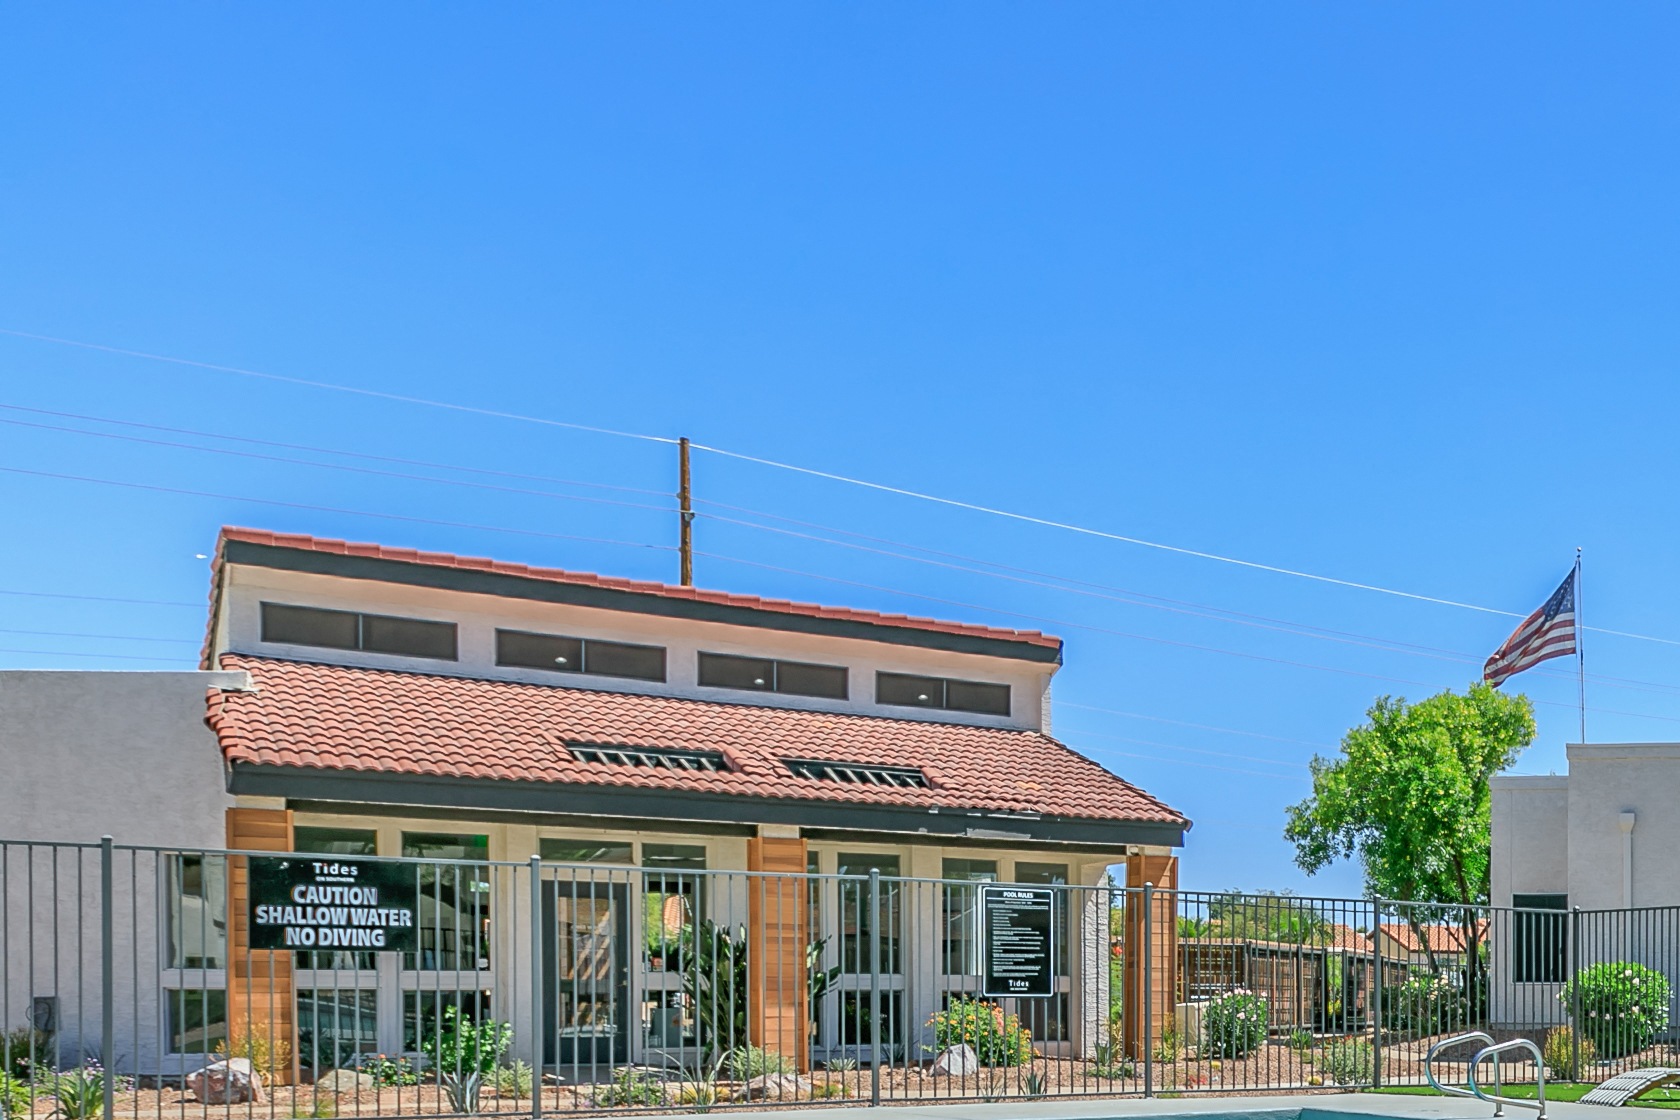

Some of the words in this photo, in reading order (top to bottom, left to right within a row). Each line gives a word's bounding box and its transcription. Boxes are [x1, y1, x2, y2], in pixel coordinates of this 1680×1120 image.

[312, 862, 358, 876] Tides
[291, 885, 378, 906] CAUTION
[256, 905, 349, 925] SHALLOW
[350, 908, 412, 927] WATER
[285, 927, 316, 946] NO
[317, 928, 385, 947] DIVING
[1008, 979, 1029, 987] Tides
